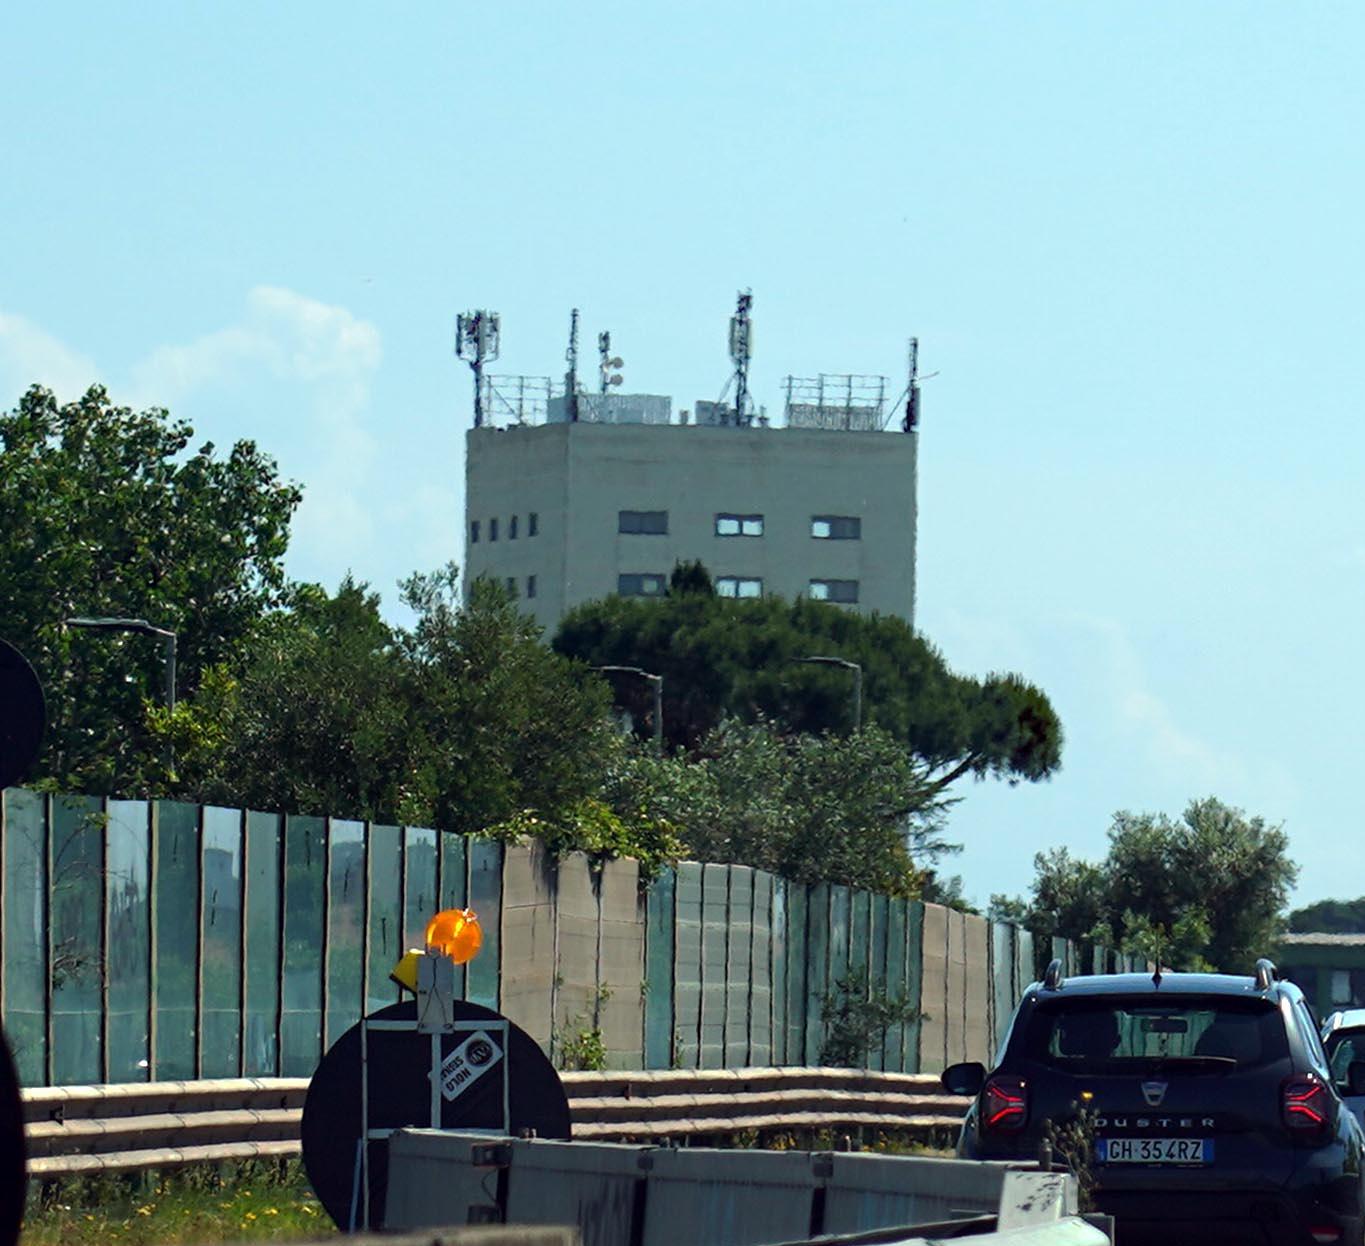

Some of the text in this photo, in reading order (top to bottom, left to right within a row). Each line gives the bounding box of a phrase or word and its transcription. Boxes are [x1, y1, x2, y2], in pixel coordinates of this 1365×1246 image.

[1094, 1118, 1215, 1127] DUSTER
[1109, 1140, 1201, 1159] GH 354RZ
